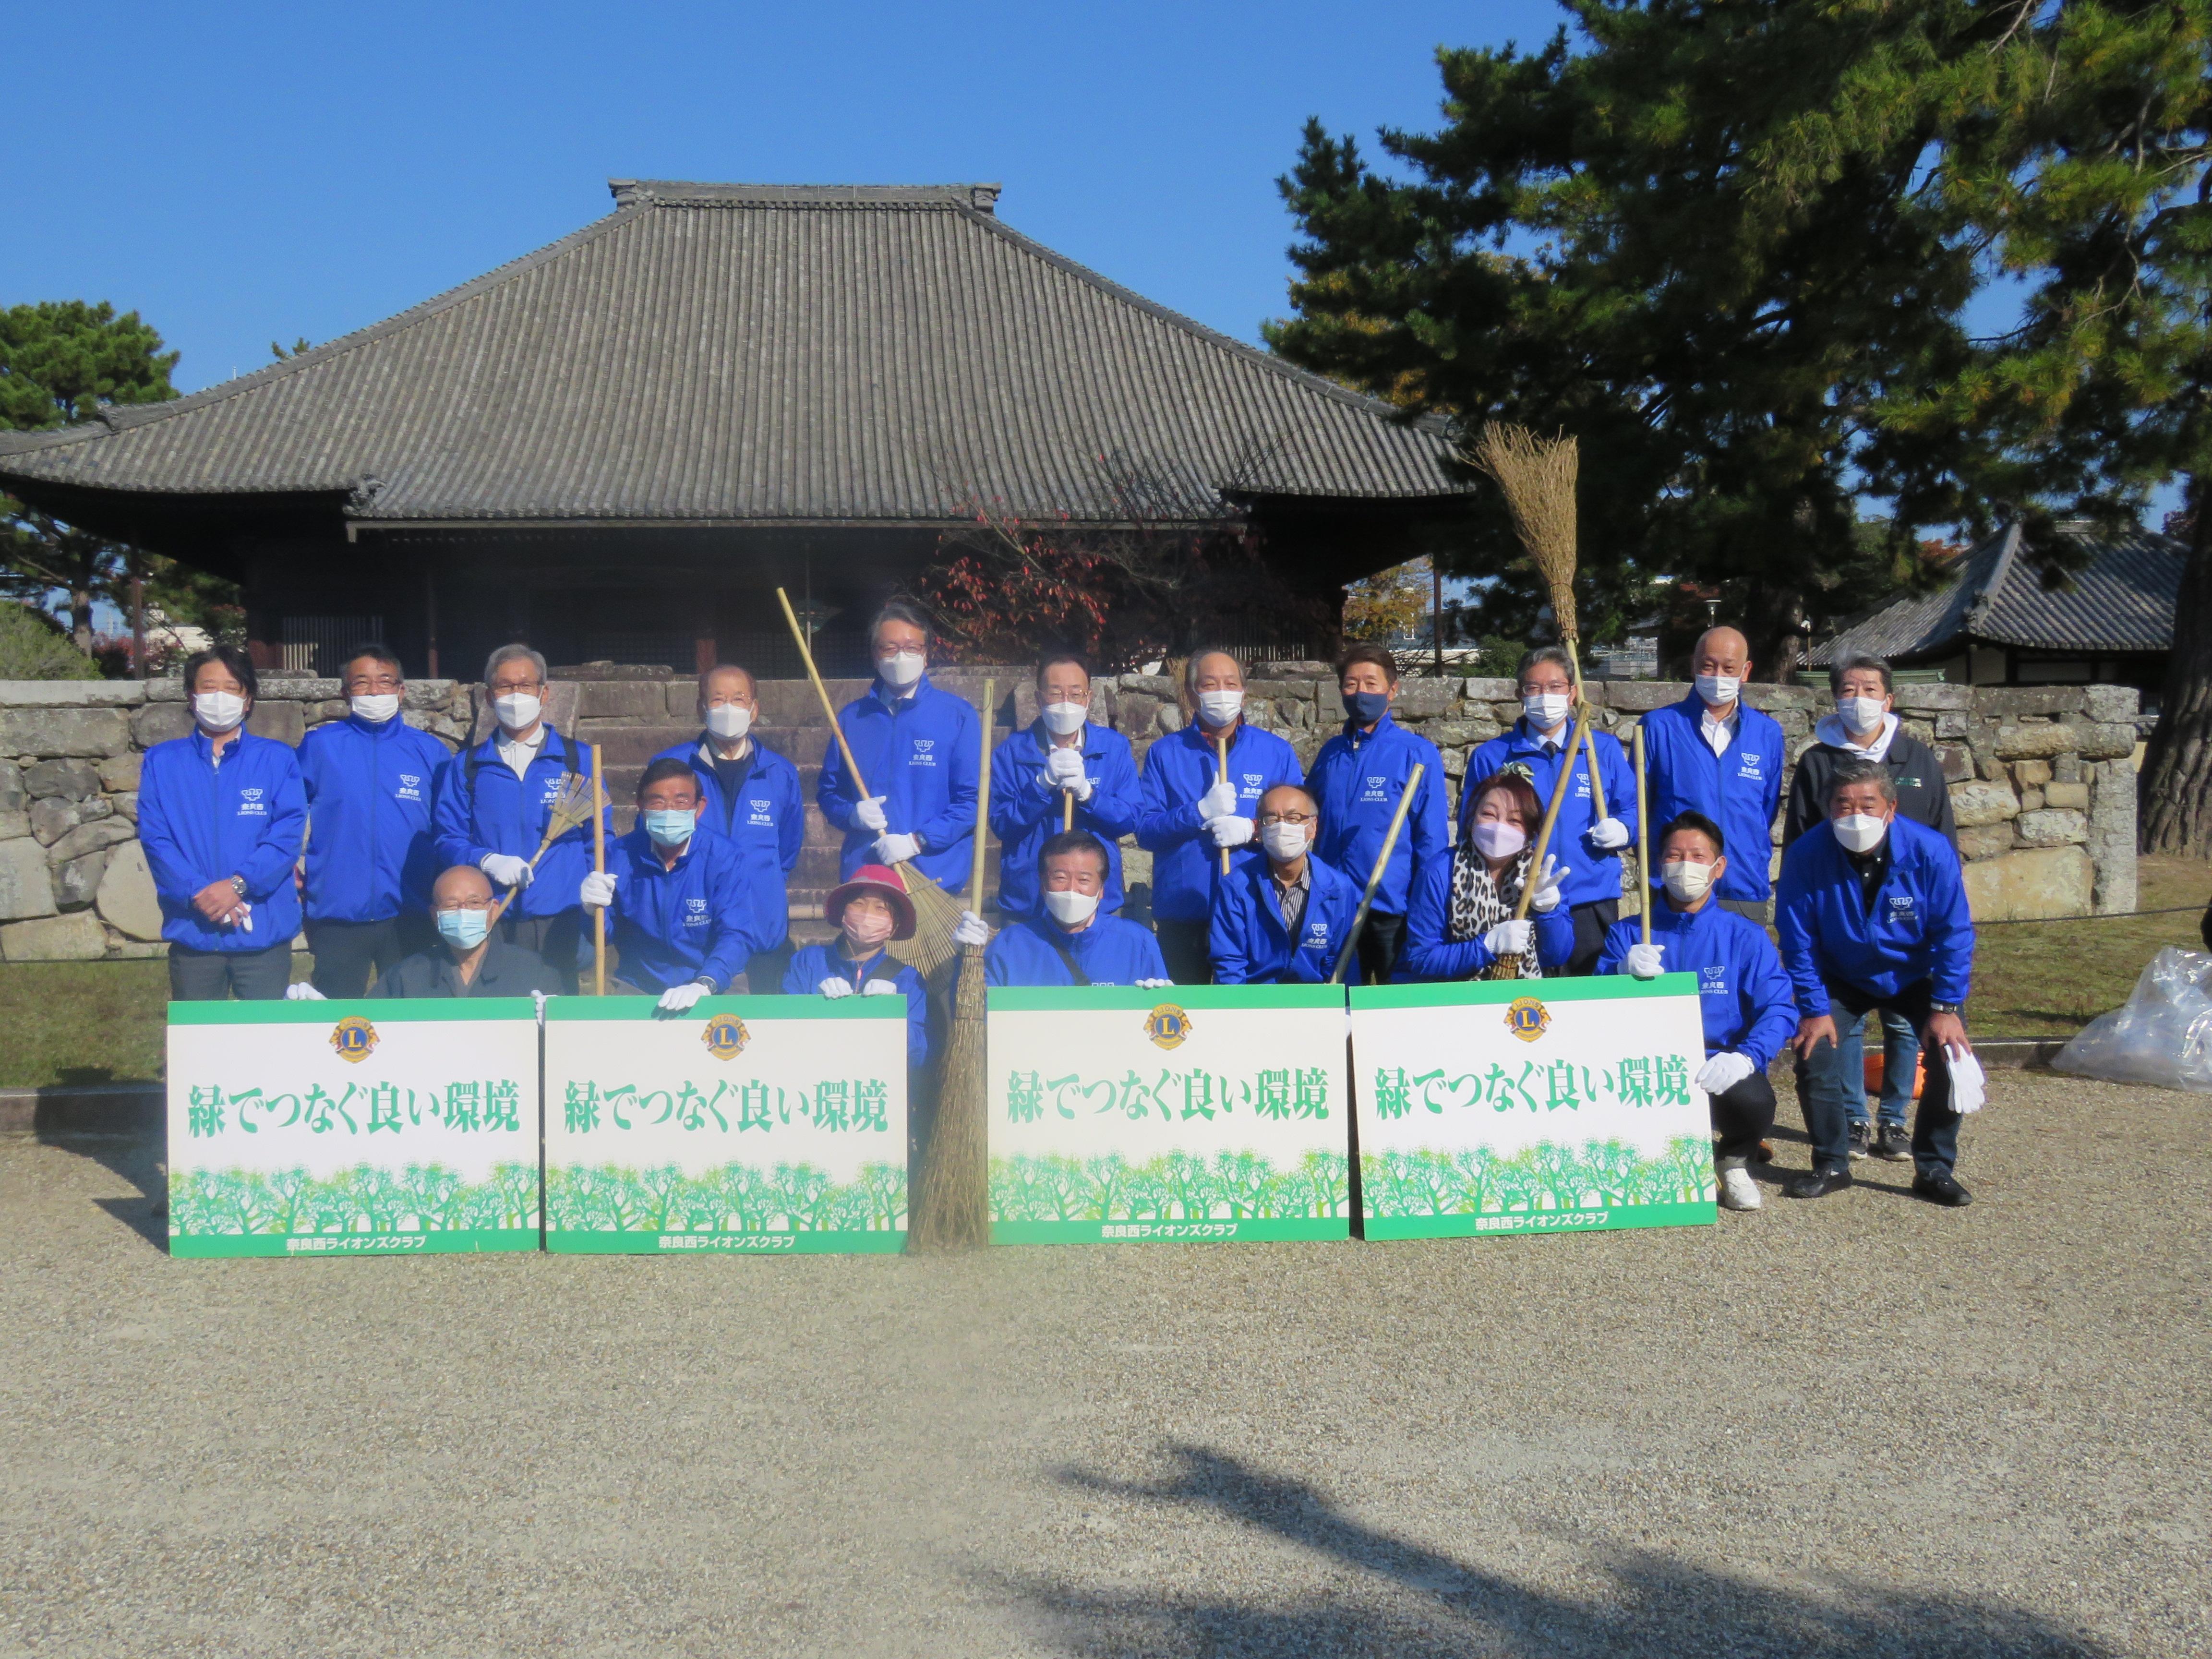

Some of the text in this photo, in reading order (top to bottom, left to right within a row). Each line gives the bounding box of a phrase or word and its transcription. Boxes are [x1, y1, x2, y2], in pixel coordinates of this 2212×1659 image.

[1162, 1017, 1176, 1035] L
[1521, 1010, 1536, 1027] L
[348, 1030, 362, 1047] L
[720, 1027, 733, 1045] L
[1008, 1067, 1329, 1123] 緑でつなぐ良い環境
[1375, 1054, 1690, 1120] 緑でつなぐ良い環境
[188, 1080, 520, 1138] 緑でつなぐ良い環境
[564, 1079, 888, 1133] 緑でつなぐ良い環境
[1475, 1211, 1609, 1230] 奈良西ライオンズクラブ
[1102, 1223, 1238, 1238] 奈良西ライオンズクラブ
[286, 1235, 427, 1250] 奈良西ライオンズクラブ
[659, 1236, 795, 1248] 奈良西ライオンズクラブ
